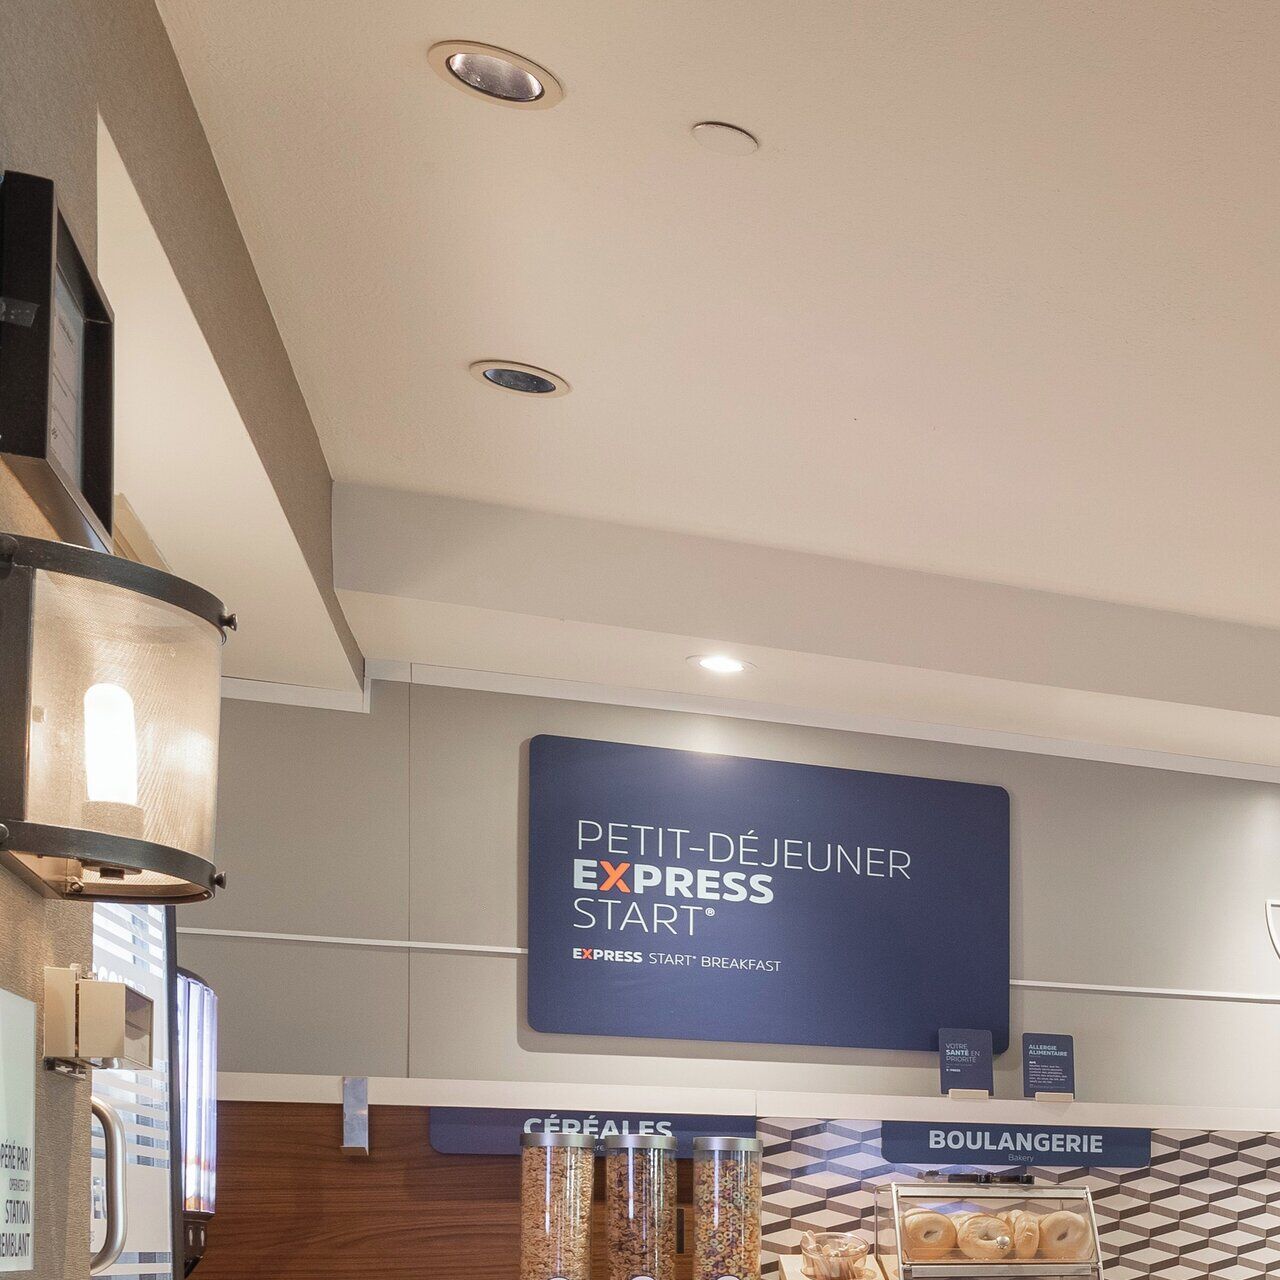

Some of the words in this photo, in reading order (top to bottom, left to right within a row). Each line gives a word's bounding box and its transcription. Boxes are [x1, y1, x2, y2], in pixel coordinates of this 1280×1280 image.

[578, 819, 911, 880] PETIT-DÉJEUNER
[573, 858, 775, 904] EXPRESS
[572, 947, 643, 963] EXPRESS
[701, 956, 782, 972] BREAKFAST
[523, 1113, 673, 1139] CÉRÉALES
[928, 1129, 1103, 1153] BOULANGERIE
[1008, 1154, 1034, 1163] Bakery
[5, 1199, 31, 1224] STATION
